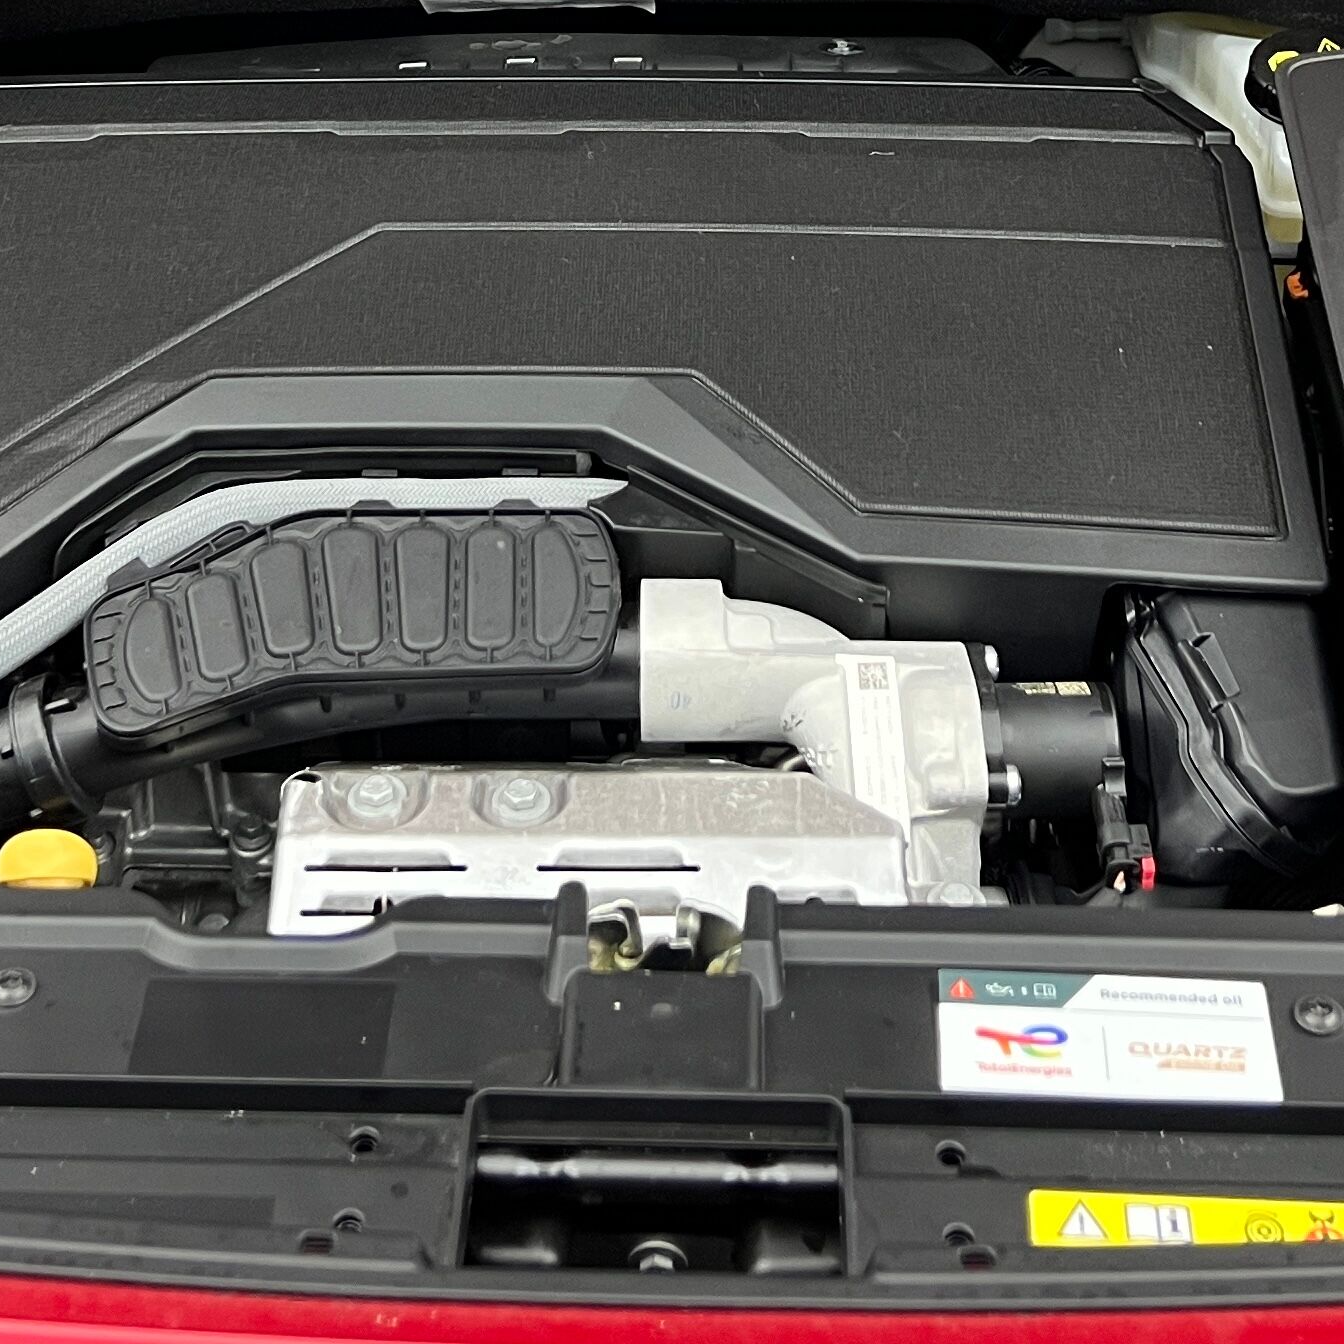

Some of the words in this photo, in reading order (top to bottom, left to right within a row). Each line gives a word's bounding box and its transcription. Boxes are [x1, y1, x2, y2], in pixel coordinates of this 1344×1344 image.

[1100, 988, 1219, 1005] Recommended
[1223, 995, 1243, 1006] oil
[1128, 1041, 1247, 1059] QUARTZ
[976, 1060, 1073, 1079] TotalEnergies
